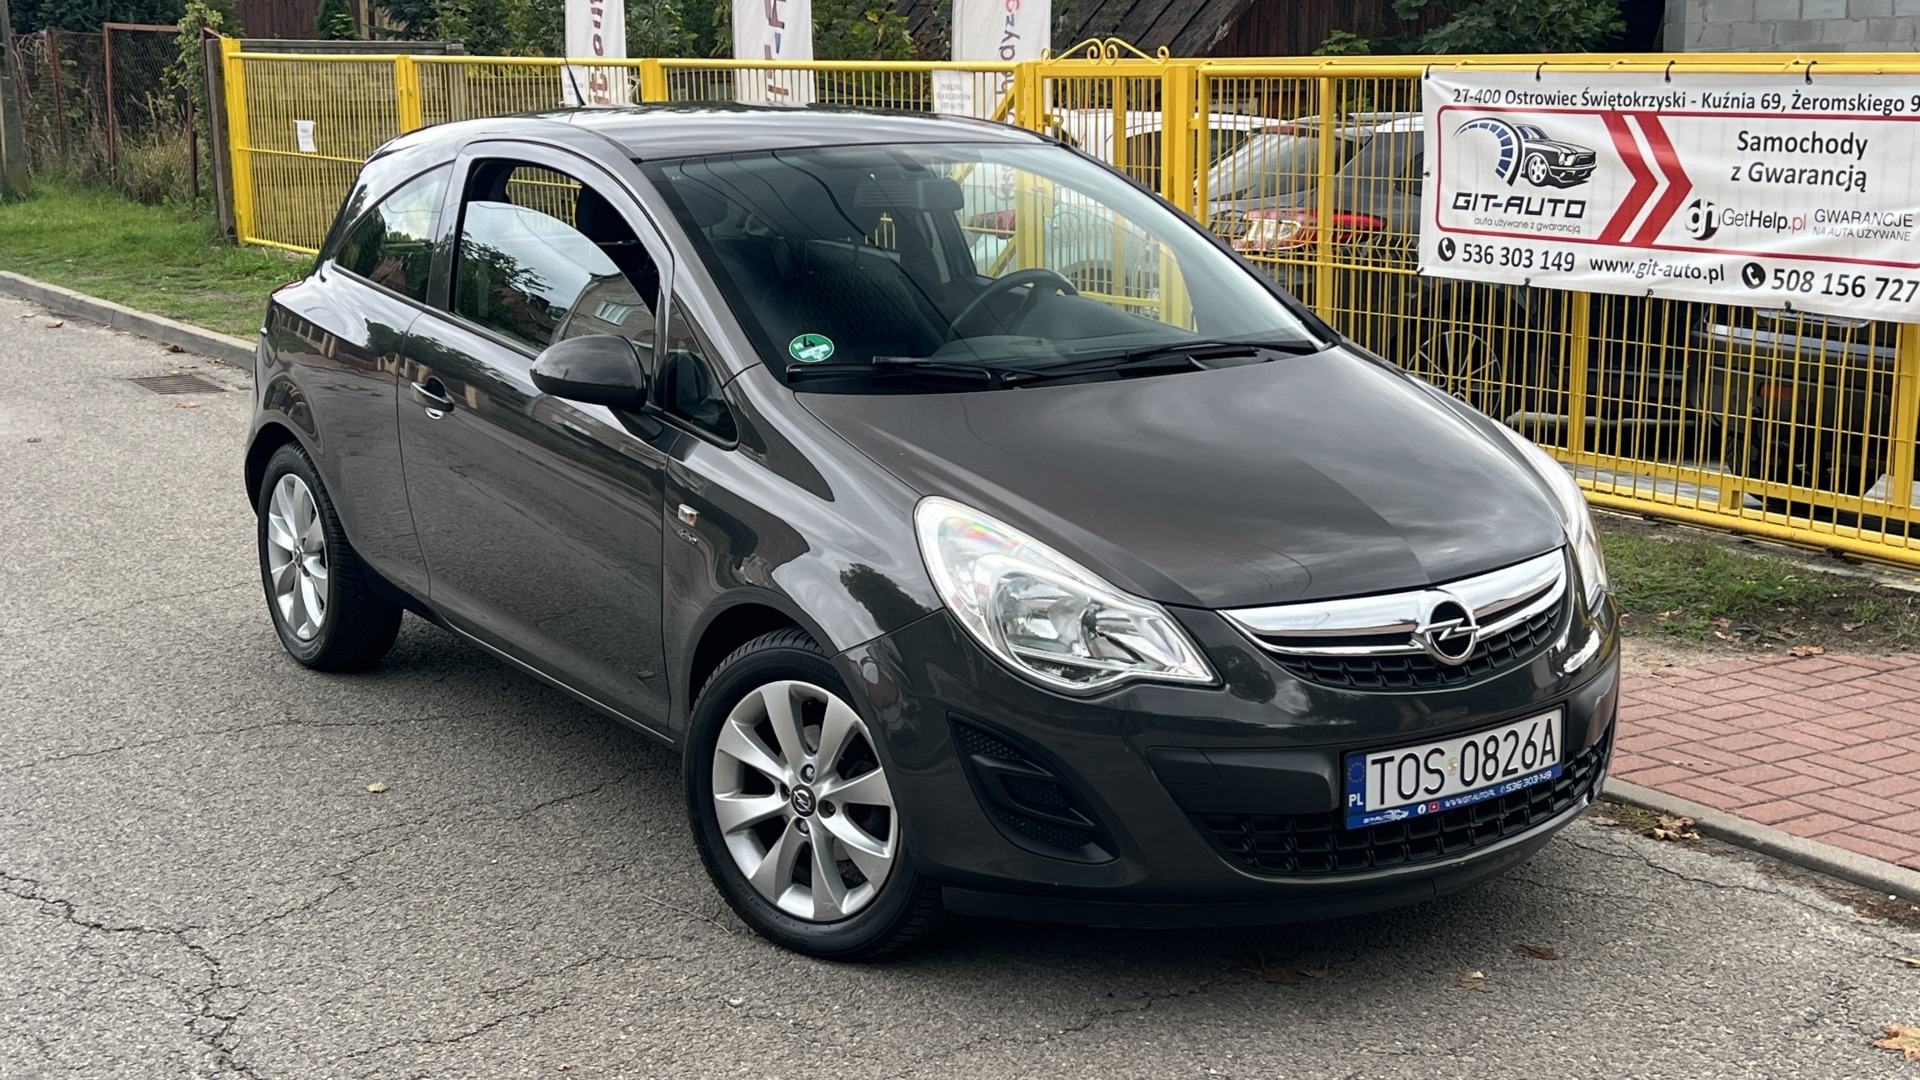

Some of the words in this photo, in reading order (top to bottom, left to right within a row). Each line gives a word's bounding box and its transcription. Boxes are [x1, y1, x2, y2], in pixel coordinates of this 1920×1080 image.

[1453, 88, 1501, 104] 27-400
[1505, 89, 1577, 106] Ostrowiec
[1581, 87, 1686, 111] Świętokrzyski
[1702, 91, 1755, 109] Kuźnia
[1761, 92, 1786, 113] 69,
[1791, 89, 1904, 116] Żeromskiego
[1737, 130, 1868, 161] Samochody
[1730, 165, 1741, 182] z
[1748, 161, 1867, 193] Gwarancją
[1452, 192, 1586, 219] GIT-AUTO
[1814, 208, 1914, 228] GWARANCJE
[1474, 216, 1492, 227] auta
[1494, 218, 1528, 230] używane
[1530, 221, 1535, 230] z
[1536, 222, 1581, 235] gwarancją
[1722, 208, 1806, 234] GetHelp.pl
[1812, 226, 1826, 236] NA
[1827, 227, 1854, 239] AUTA
[1462, 243, 1494, 265] 536
[1500, 246, 1534, 269] 303
[1539, 249, 1575, 272] 149
[1590, 258, 1724, 285] www.git-auto.pl
[1771, 268, 1815, 294] 508
[1821, 273, 1866, 298] 156
[1874, 277, 1920, 304] 727
[1370, 747, 1445, 806] TOS
[1460, 718, 1556, 787] 0826A
[1348, 793, 1364, 808] PL
